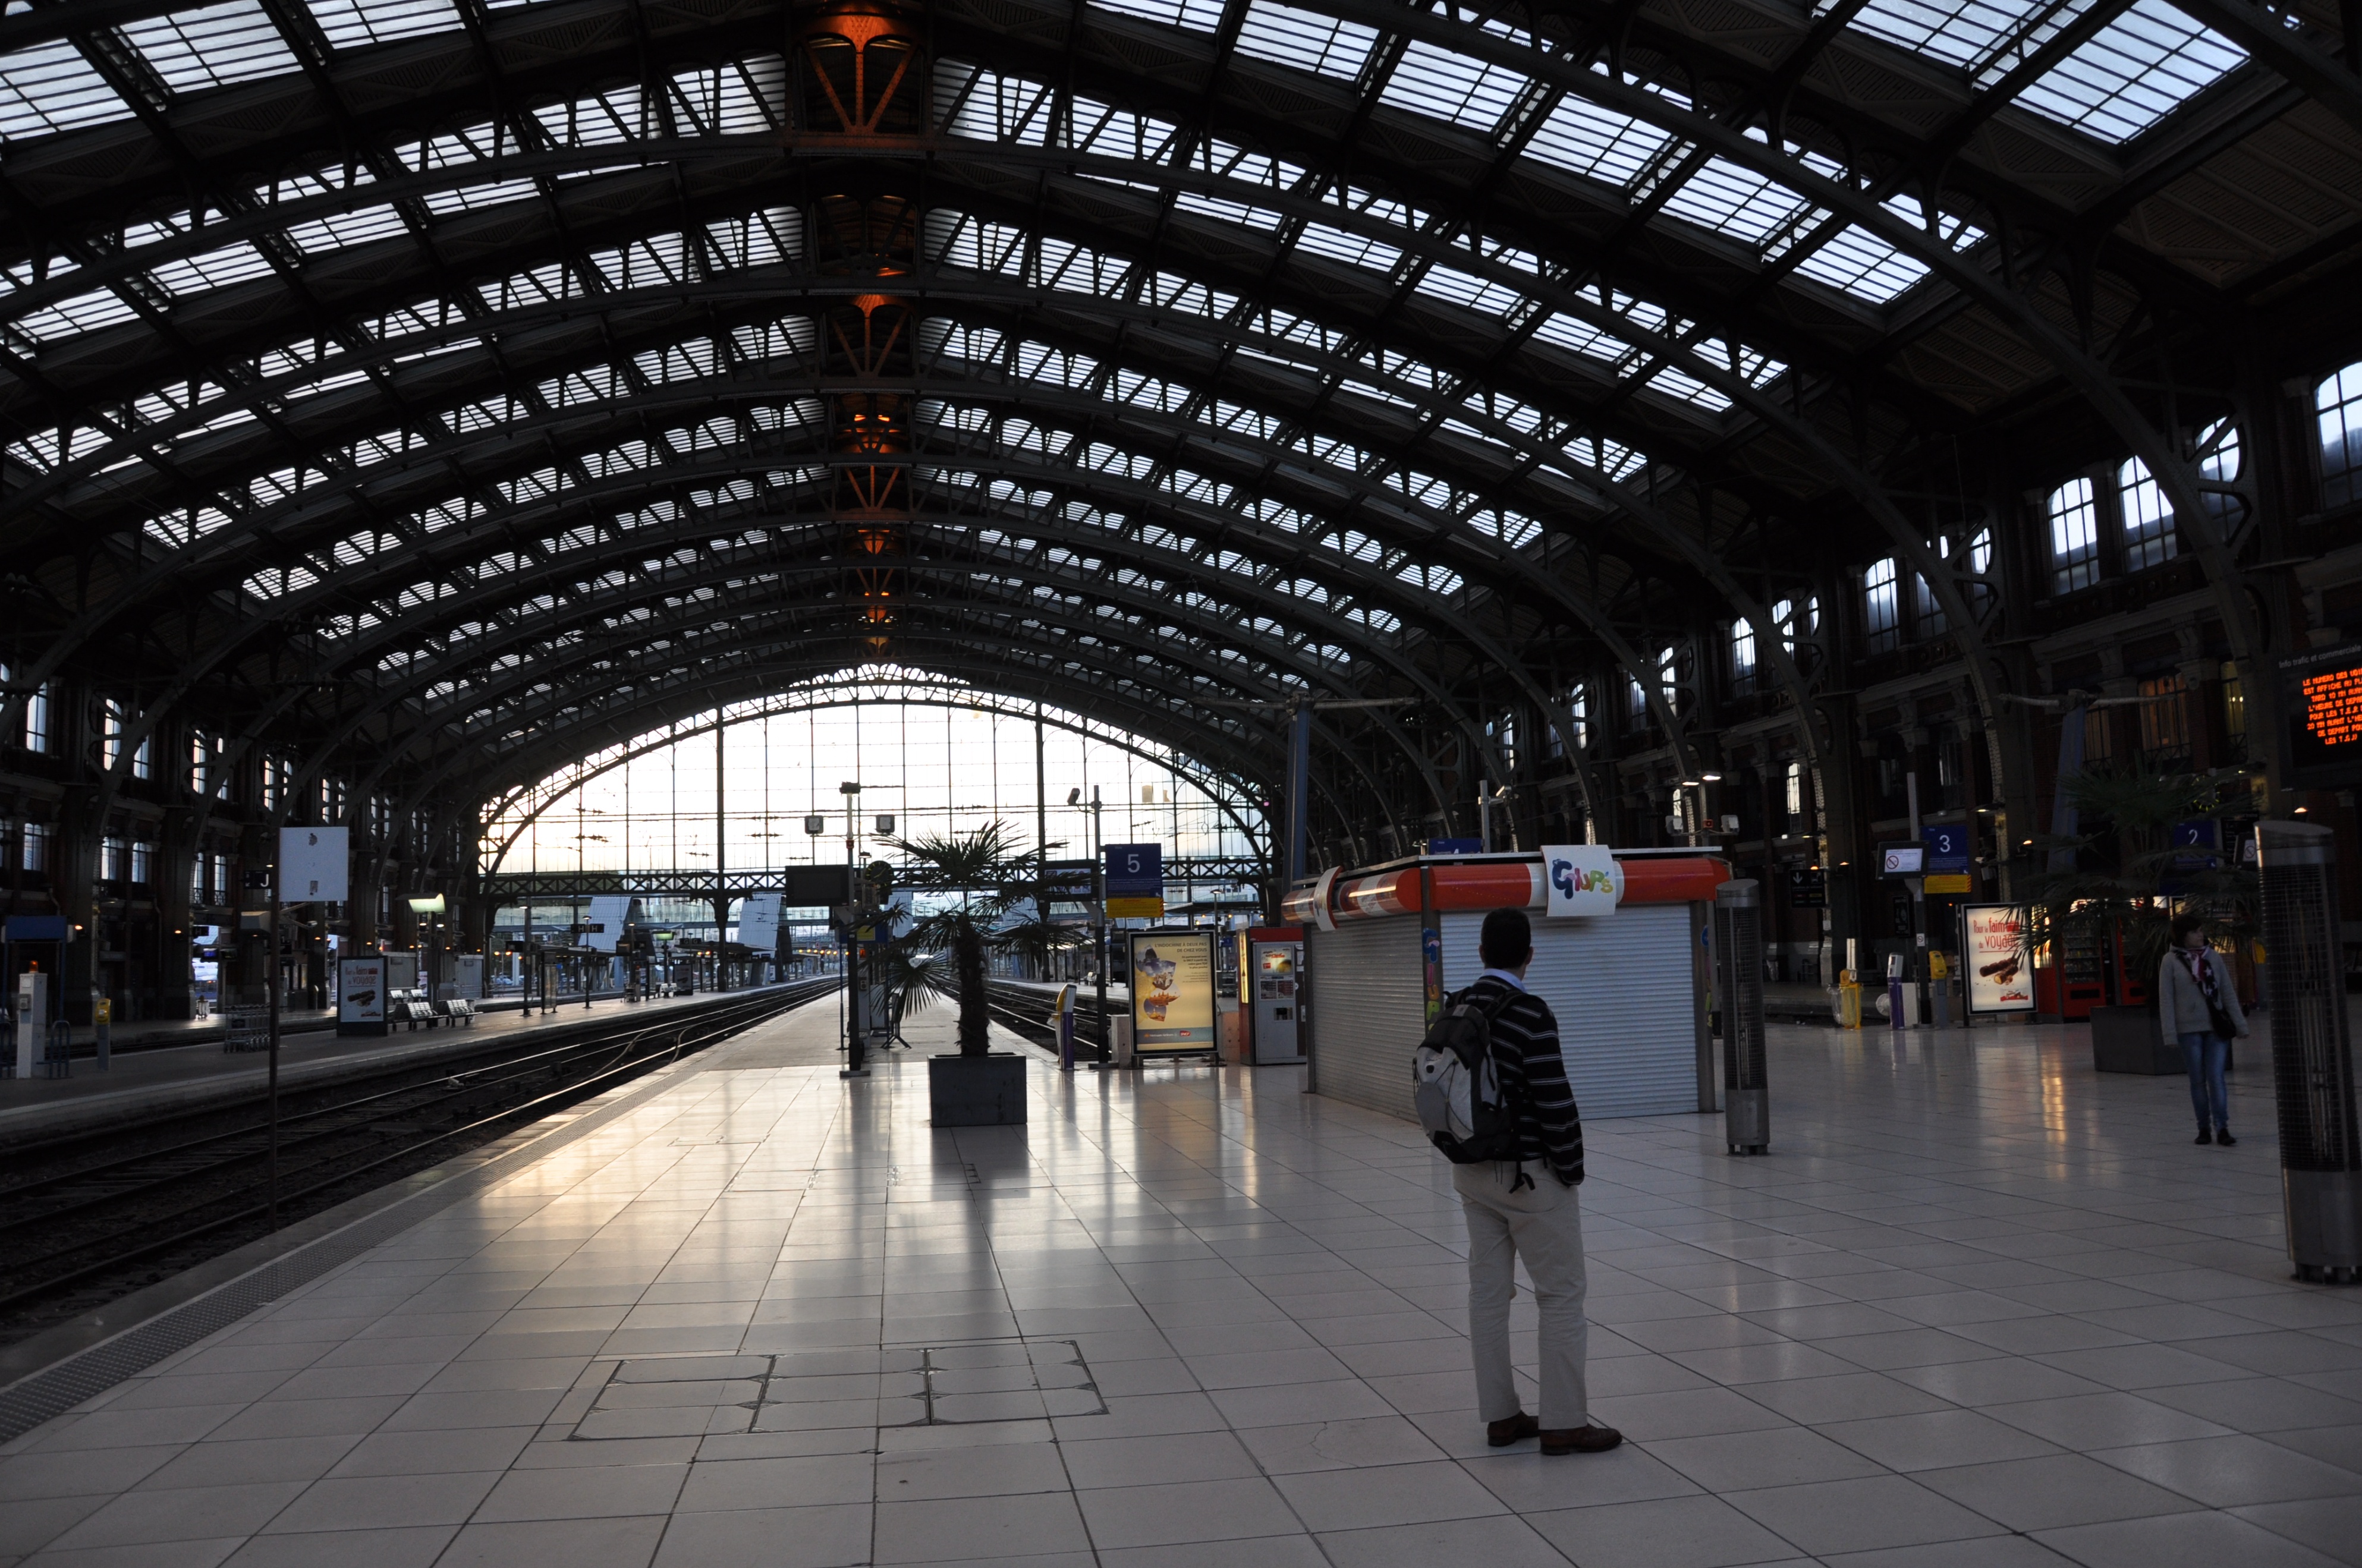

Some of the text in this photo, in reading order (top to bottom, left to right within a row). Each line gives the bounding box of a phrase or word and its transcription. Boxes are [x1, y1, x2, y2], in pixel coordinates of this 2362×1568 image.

[2279, 660, 2291, 669] Info
[2292, 656, 2309, 666] trafic
[2313, 674, 2334, 684] NUMERO
[2336, 670, 2348, 680] DES
[2303, 687, 2314, 695] EST
[2317, 681, 2342, 692] AFFICHE
[2311, 694, 2326, 703] TARD
[2308, 701, 2333, 712] L'HEURE
[2335, 699, 2344, 707] DE
[2309, 712, 2324, 720] POUR
[2326, 710, 2338, 718] LES
[2327, 717, 2345, 726] AVANT
[2328, 725, 2349, 736] DEPART
[2325, 737, 2336, 745] LES
[1939, 835, 1951, 852] 3
[1127, 854, 1141, 873] 5
[260, 873, 269, 887] J
[1973, 920, 1983, 933] Pour
[1989, 917, 2005, 933] faim
